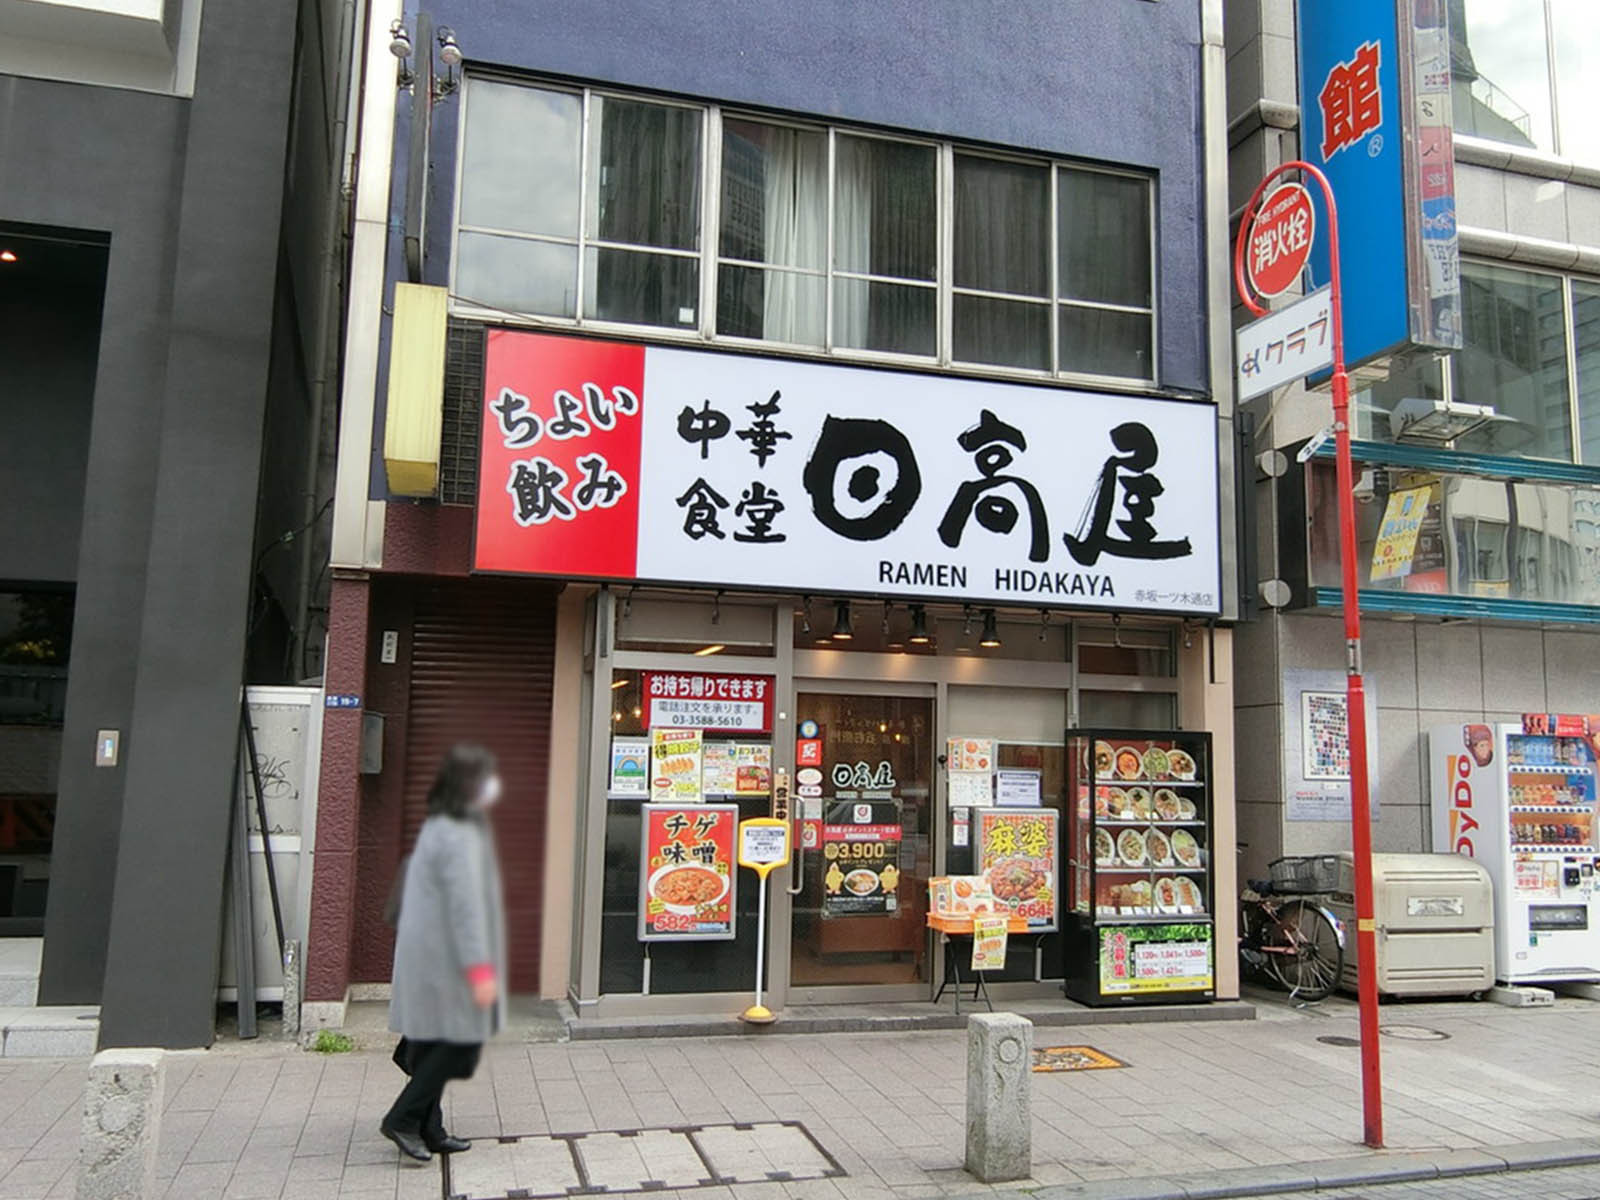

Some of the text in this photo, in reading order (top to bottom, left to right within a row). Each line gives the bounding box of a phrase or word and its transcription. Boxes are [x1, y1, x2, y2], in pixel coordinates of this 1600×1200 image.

[1320, 40, 1383, 163] 館
[1254, 207, 1308, 275] 消火栓
[490, 383, 638, 449] ちょい
[677, 390, 793, 468] 中華
[507, 453, 627, 527] 飲み
[675, 477, 787, 543] 食堂
[803, 409, 1192, 566] 日高屋
[879, 560, 1115, 598] RAMEN HIDAKAYA
[650, 675, 768, 699] お持ち帰りできます
[672, 714, 743, 727] 03-3588-5610
[832, 761, 897, 789] 日高屋
[661, 840, 717, 865] 味噌
[664, 813, 718, 840] チゲ
[986, 819, 1049, 859] 麻婆
